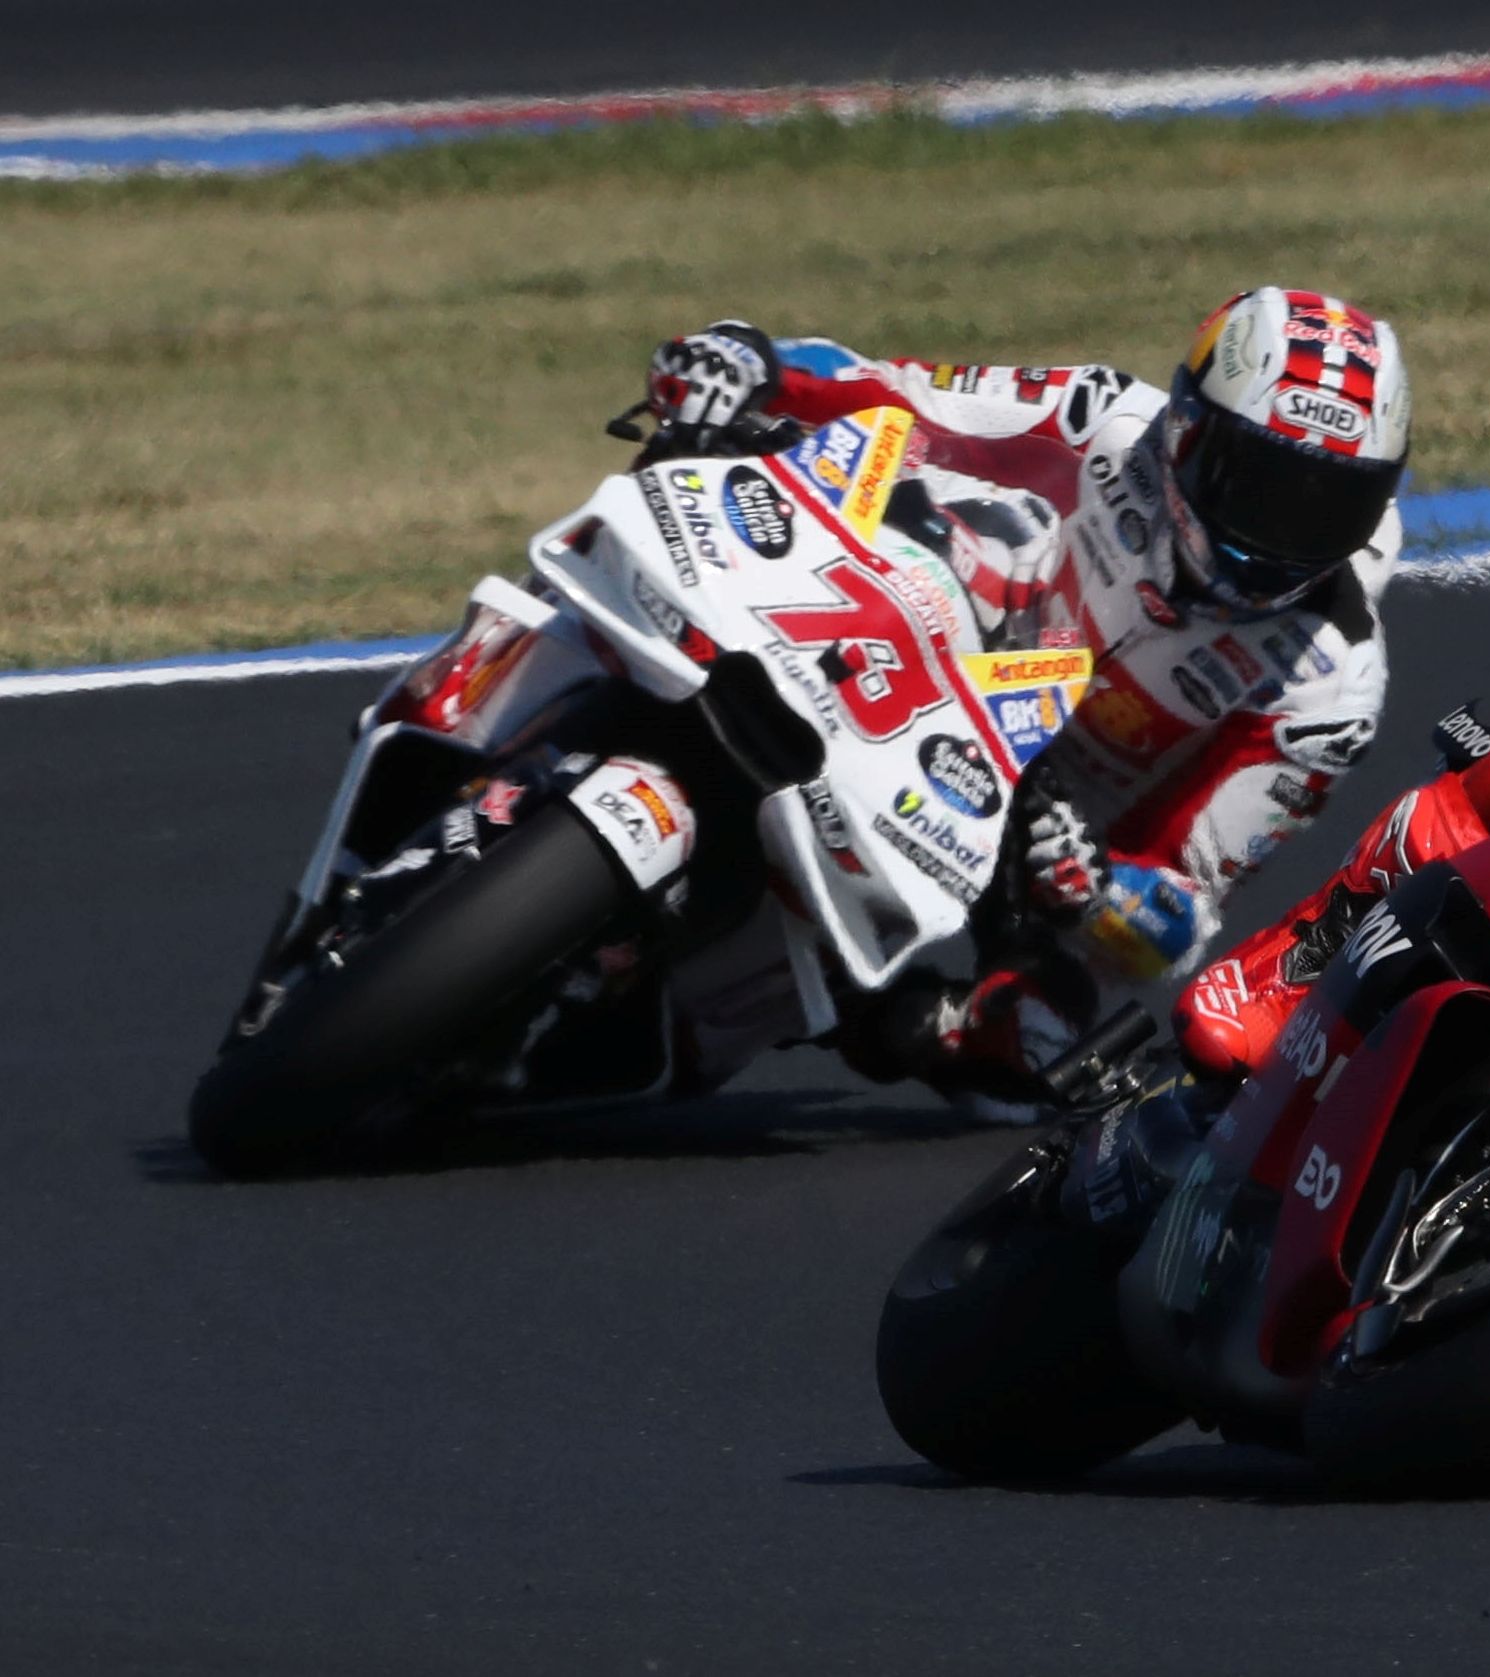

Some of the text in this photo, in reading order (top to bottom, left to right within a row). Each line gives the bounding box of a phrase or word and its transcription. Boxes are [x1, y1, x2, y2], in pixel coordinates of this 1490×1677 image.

[1284, 319, 1333, 342] Red
[1290, 394, 1356, 430] SHOEI
[750, 556, 952, 743] 73
